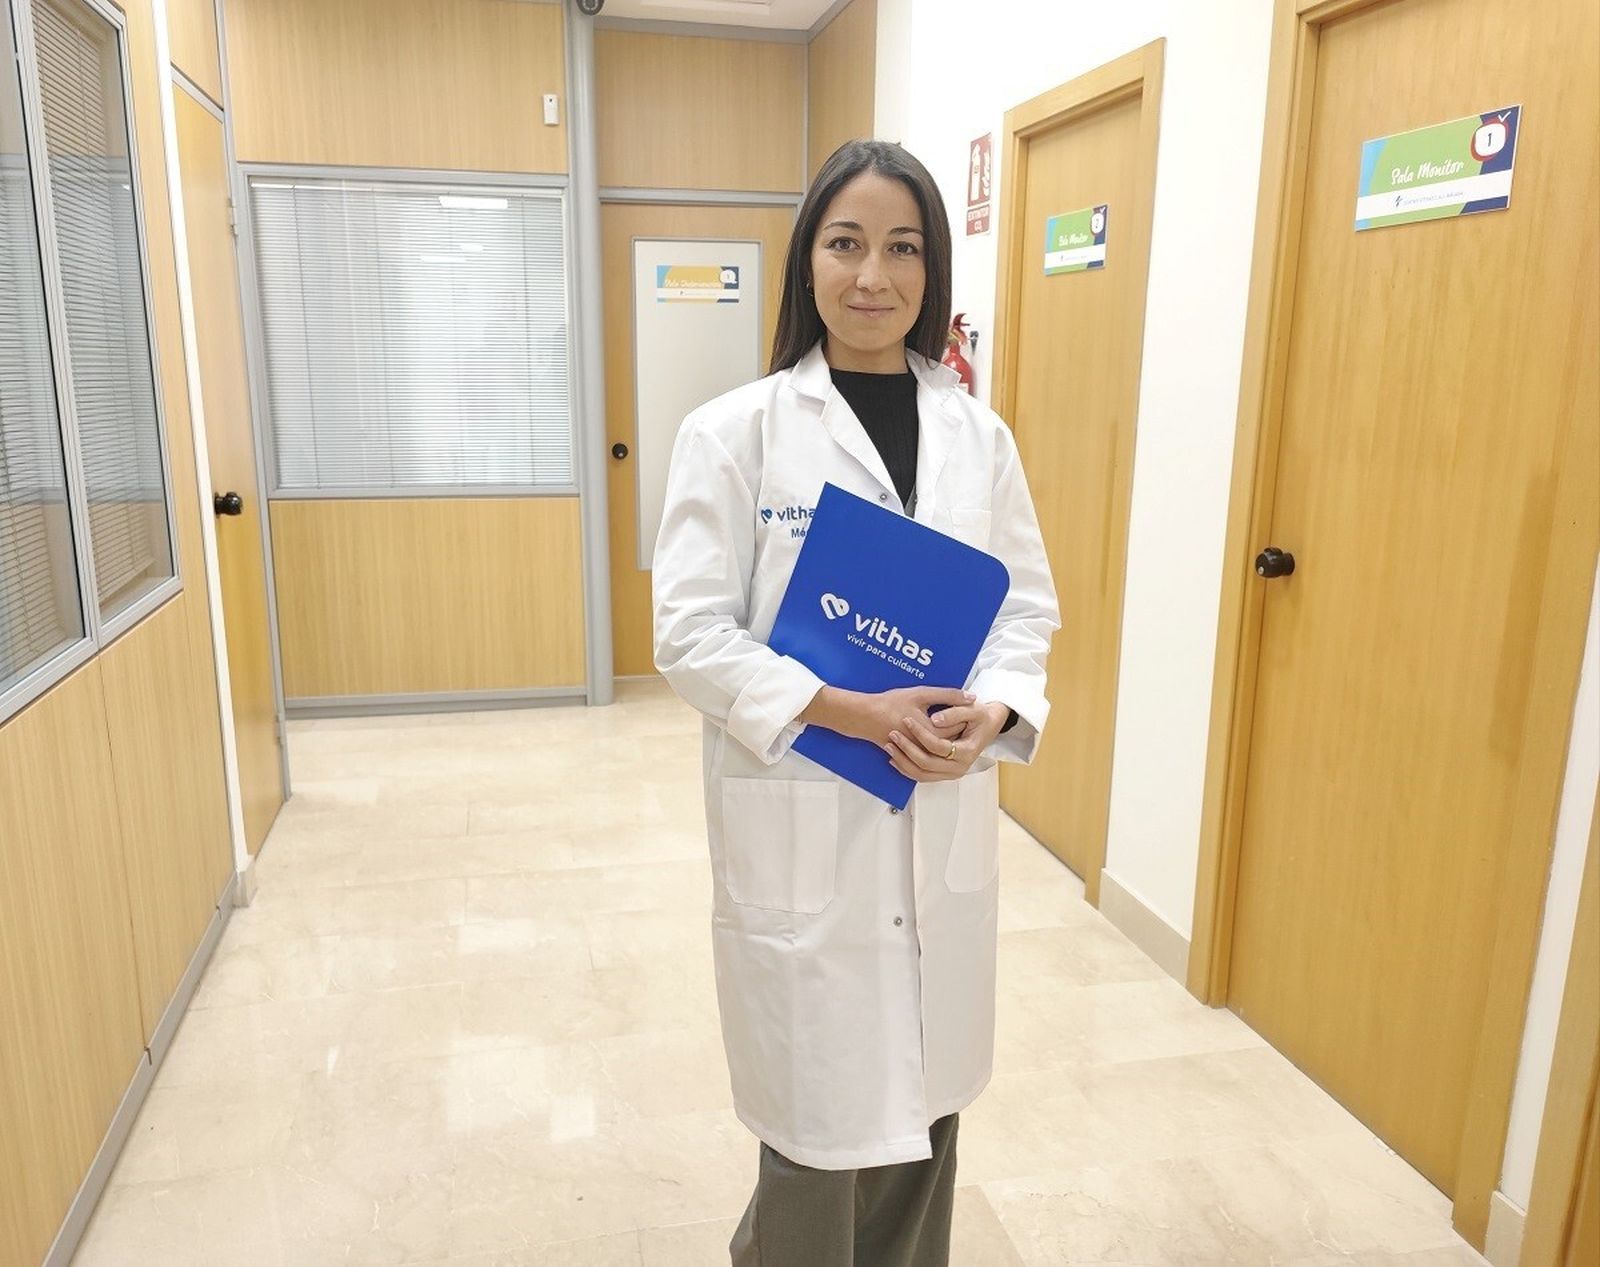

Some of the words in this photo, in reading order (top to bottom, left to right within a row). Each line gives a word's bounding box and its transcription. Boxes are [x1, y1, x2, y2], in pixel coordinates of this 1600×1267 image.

[1487, 133, 1492, 147] 1
[1417, 159, 1464, 179] Monitor
[855, 613, 934, 666] vithas
[847, 633, 866, 648] vivir
[865, 643, 887, 660] para
[887, 653, 925, 680] cuidarte
